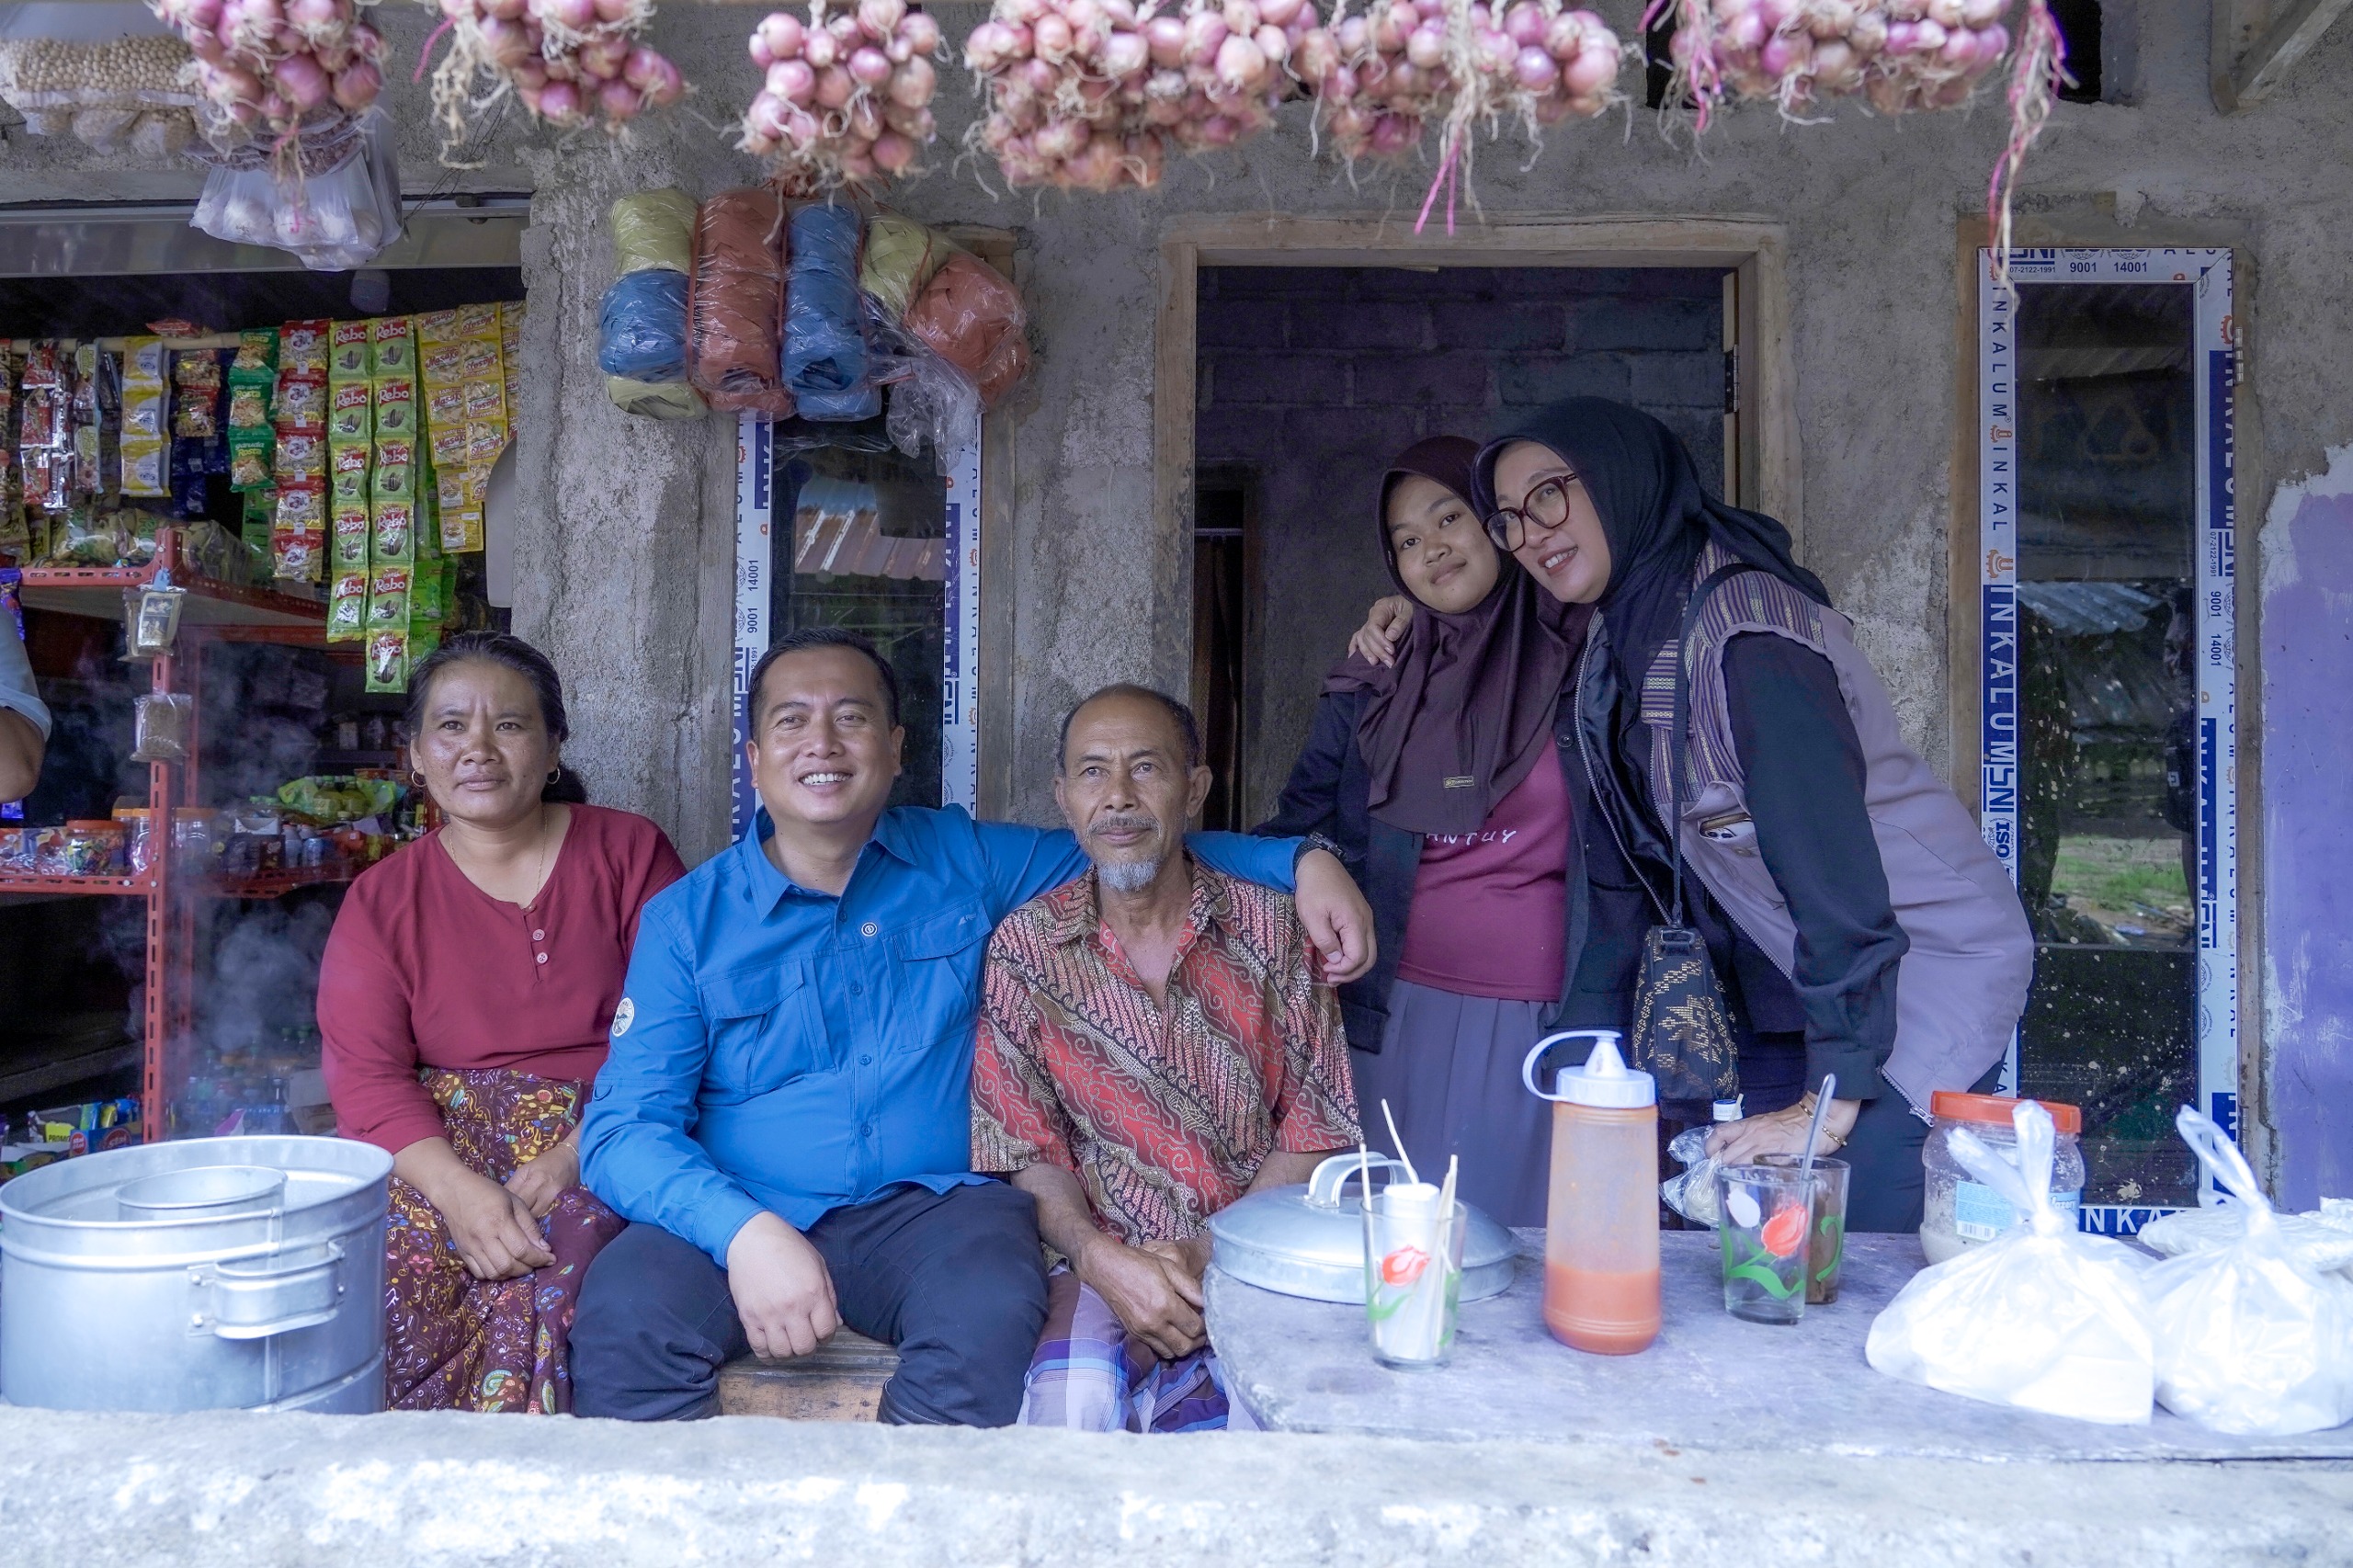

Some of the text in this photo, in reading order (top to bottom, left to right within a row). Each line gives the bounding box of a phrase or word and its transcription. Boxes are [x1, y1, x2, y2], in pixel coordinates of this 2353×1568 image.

[2070, 262, 2147, 273] 9001 14001
[335, 328, 367, 345] Rebo
[376, 324, 406, 341] Rebo
[336, 392, 367, 408] Rebo
[379, 387, 409, 404] Rebo
[238, 449, 263, 457] Rosta
[380, 449, 408, 466] Rebo
[1993, 447, 2007, 531] INKAL
[748, 560, 759, 592] 14001
[375, 577, 405, 595] Rebo
[2210, 591, 2222, 619] 9001
[747, 608, 757, 633] 9001
[2210, 633, 2222, 667] 14001
[1990, 585, 2014, 763] INKALUM
[1995, 822, 2010, 858] ISO
